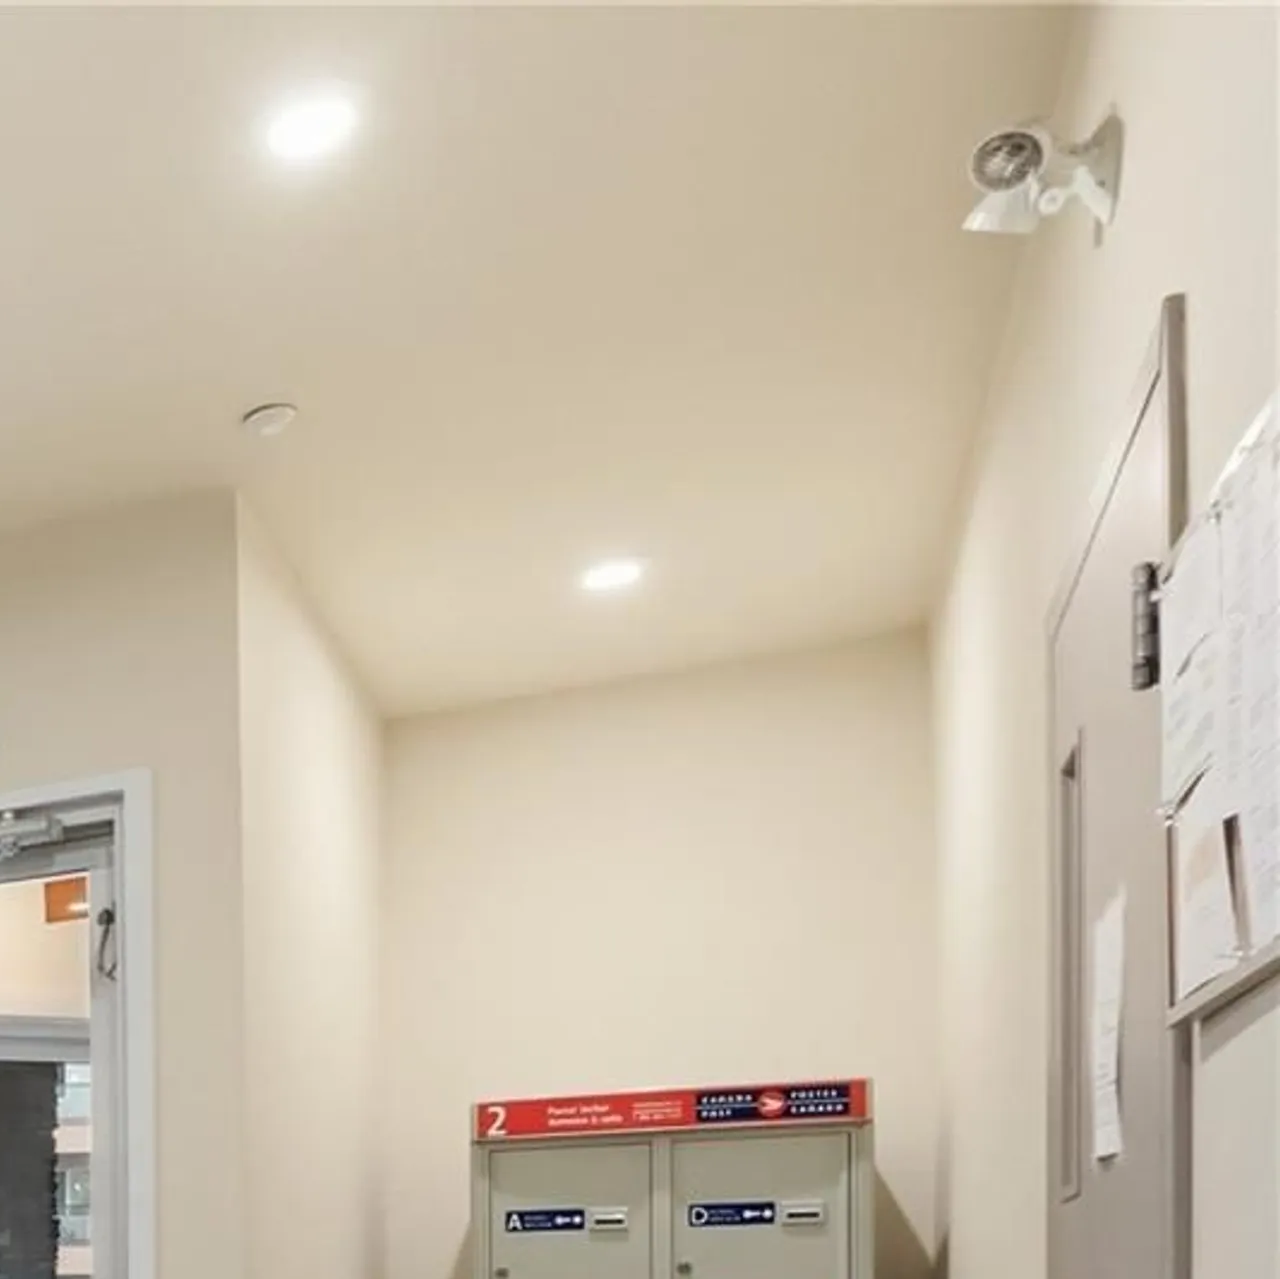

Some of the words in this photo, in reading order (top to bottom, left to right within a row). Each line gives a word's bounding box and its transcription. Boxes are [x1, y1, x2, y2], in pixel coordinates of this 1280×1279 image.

[487, 1106, 507, 1135] 2
[507, 1213, 522, 1230] A
[691, 1207, 708, 1224] D
